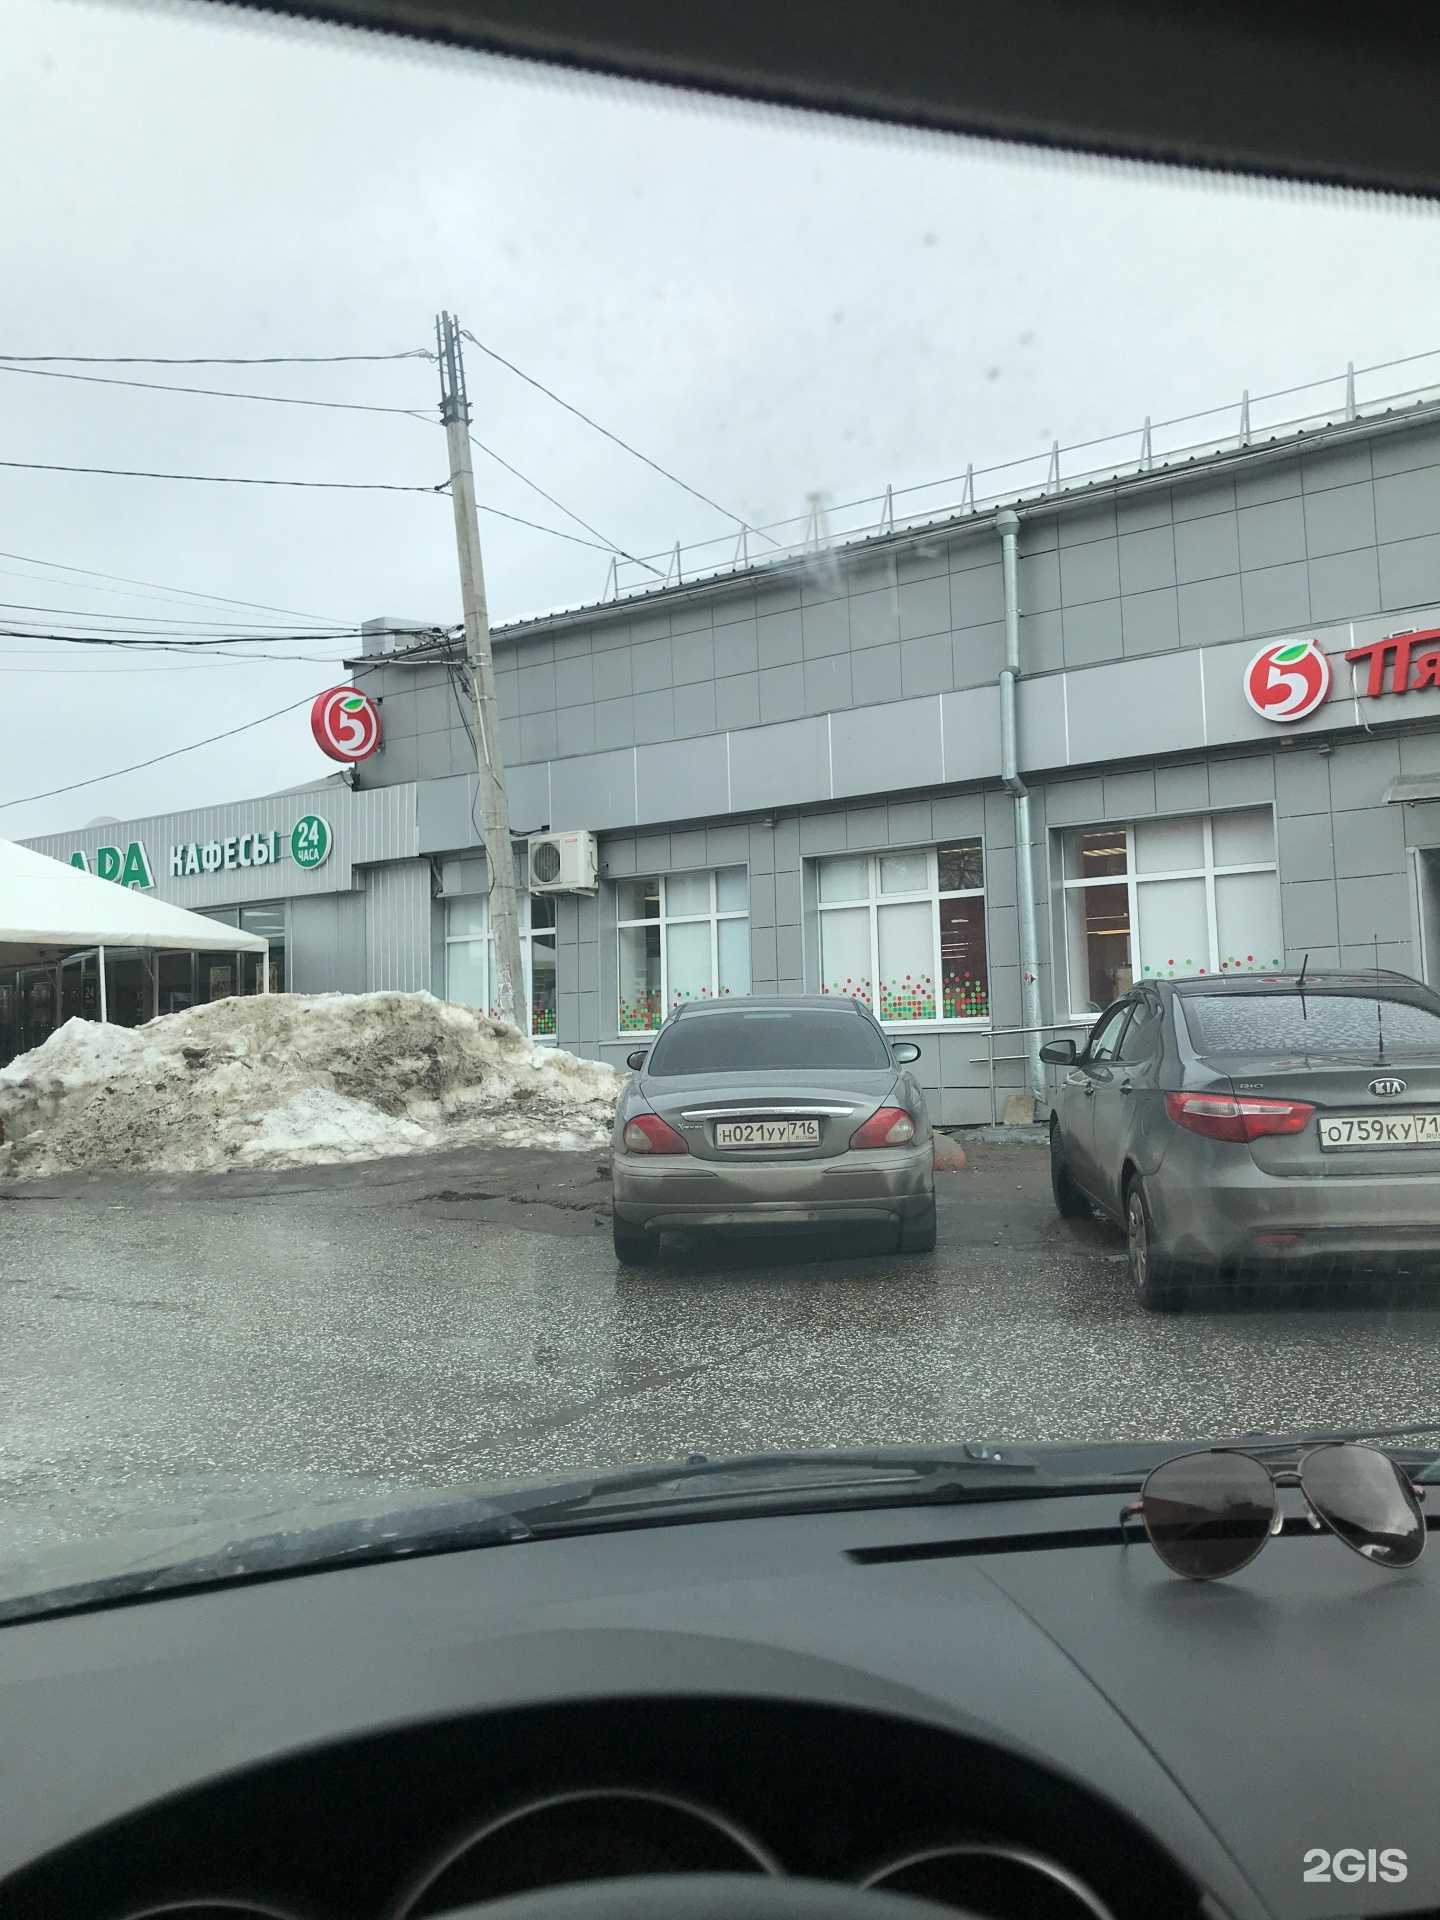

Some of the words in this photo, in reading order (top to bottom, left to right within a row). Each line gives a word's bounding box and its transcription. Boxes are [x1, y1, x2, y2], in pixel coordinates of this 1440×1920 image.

[1264, 666, 1309, 714] 5
[339, 711, 366, 750] 5
[298, 820, 319, 847] 24
[170, 831, 276, 876] КАФЕСЫ
[298, 848, 320, 861] ЧАСА
